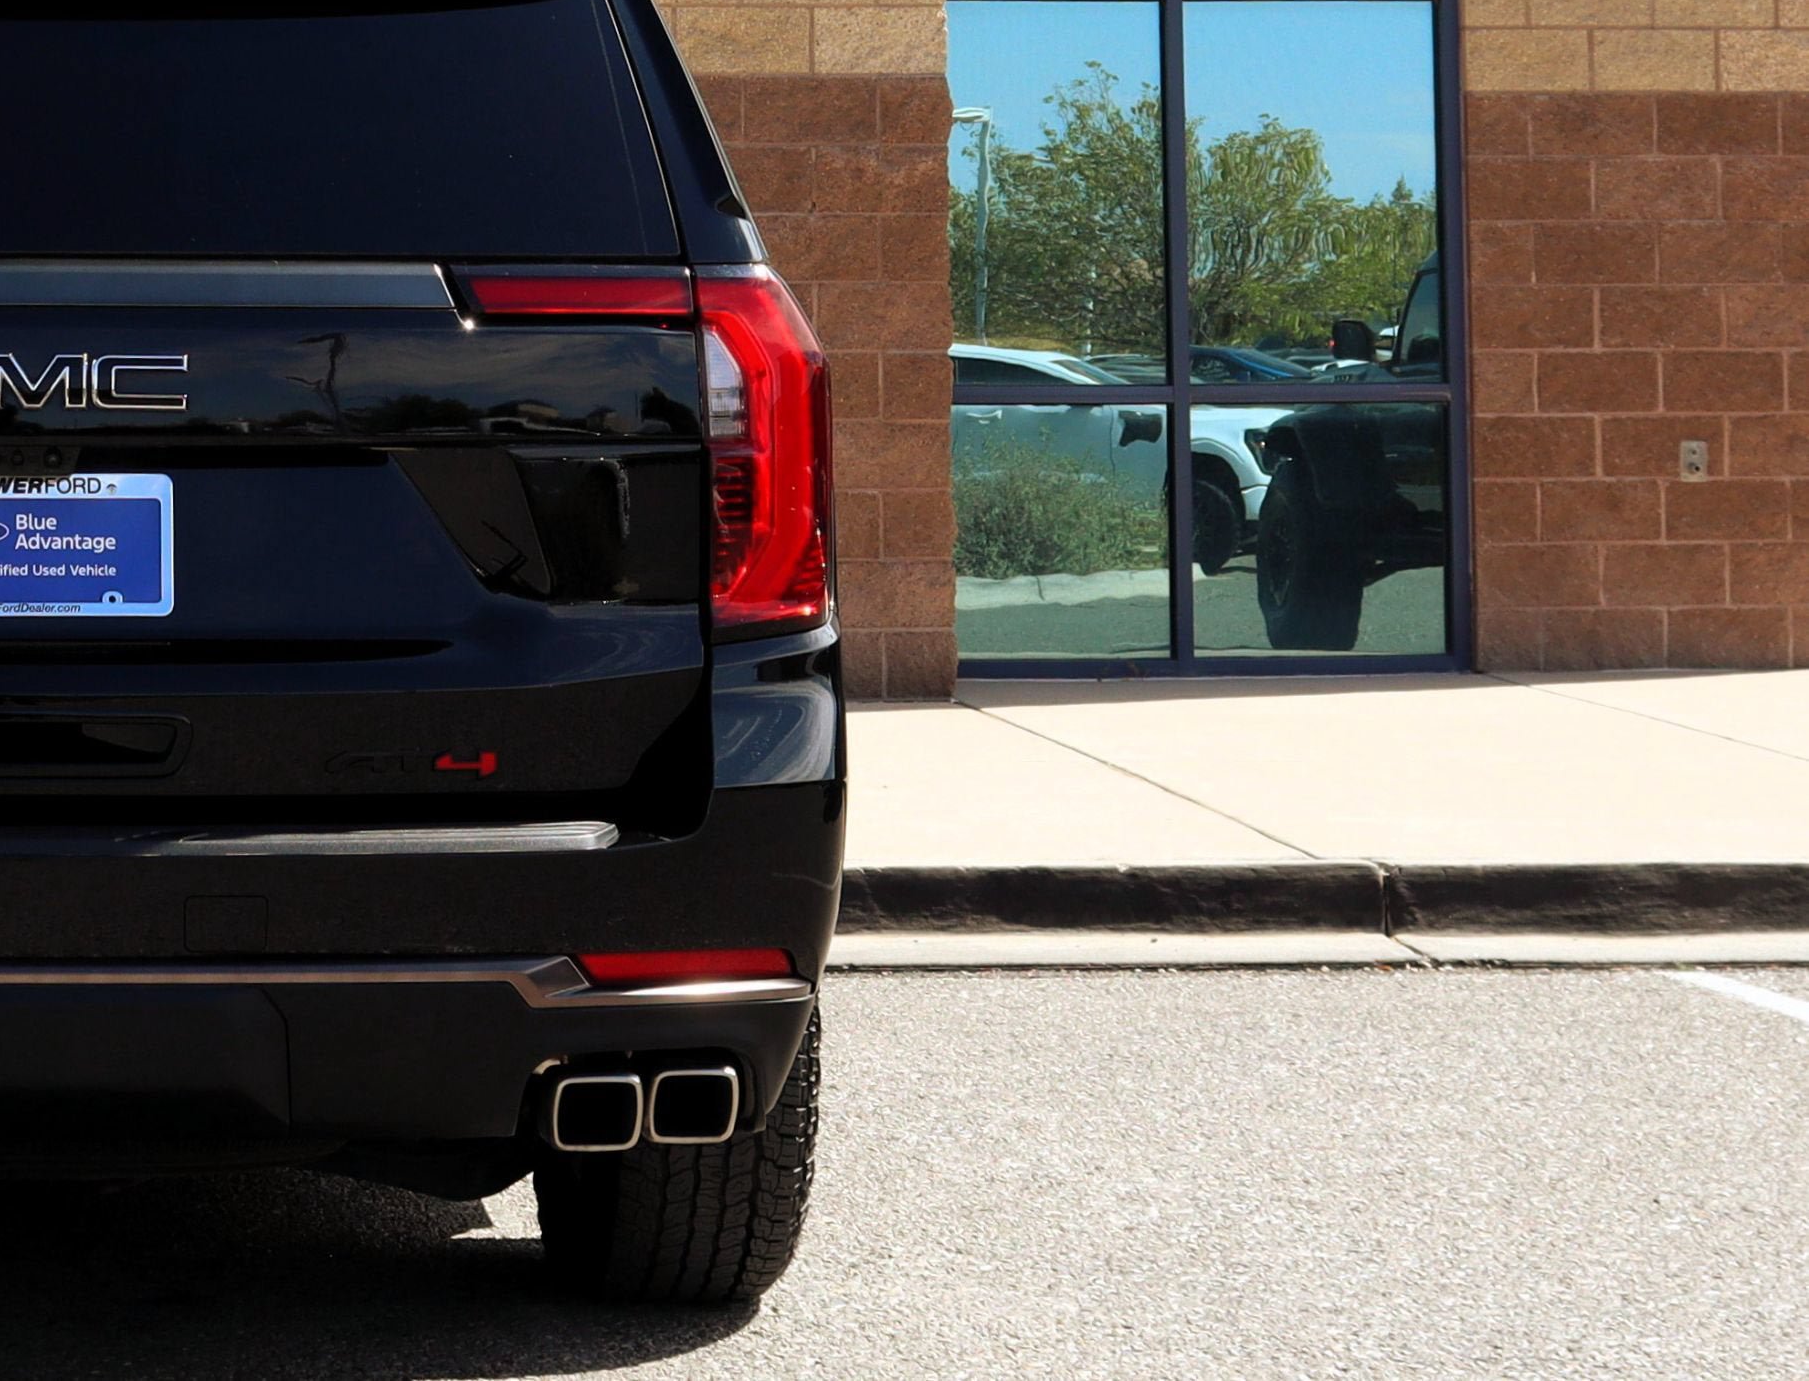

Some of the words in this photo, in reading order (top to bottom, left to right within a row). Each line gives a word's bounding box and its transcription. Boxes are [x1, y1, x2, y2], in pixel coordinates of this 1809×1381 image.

[15, 513, 57, 530] Blue
[15, 533, 116, 553] Advantage
[32, 564, 66, 576] Used
[69, 564, 117, 576] Vehicle
